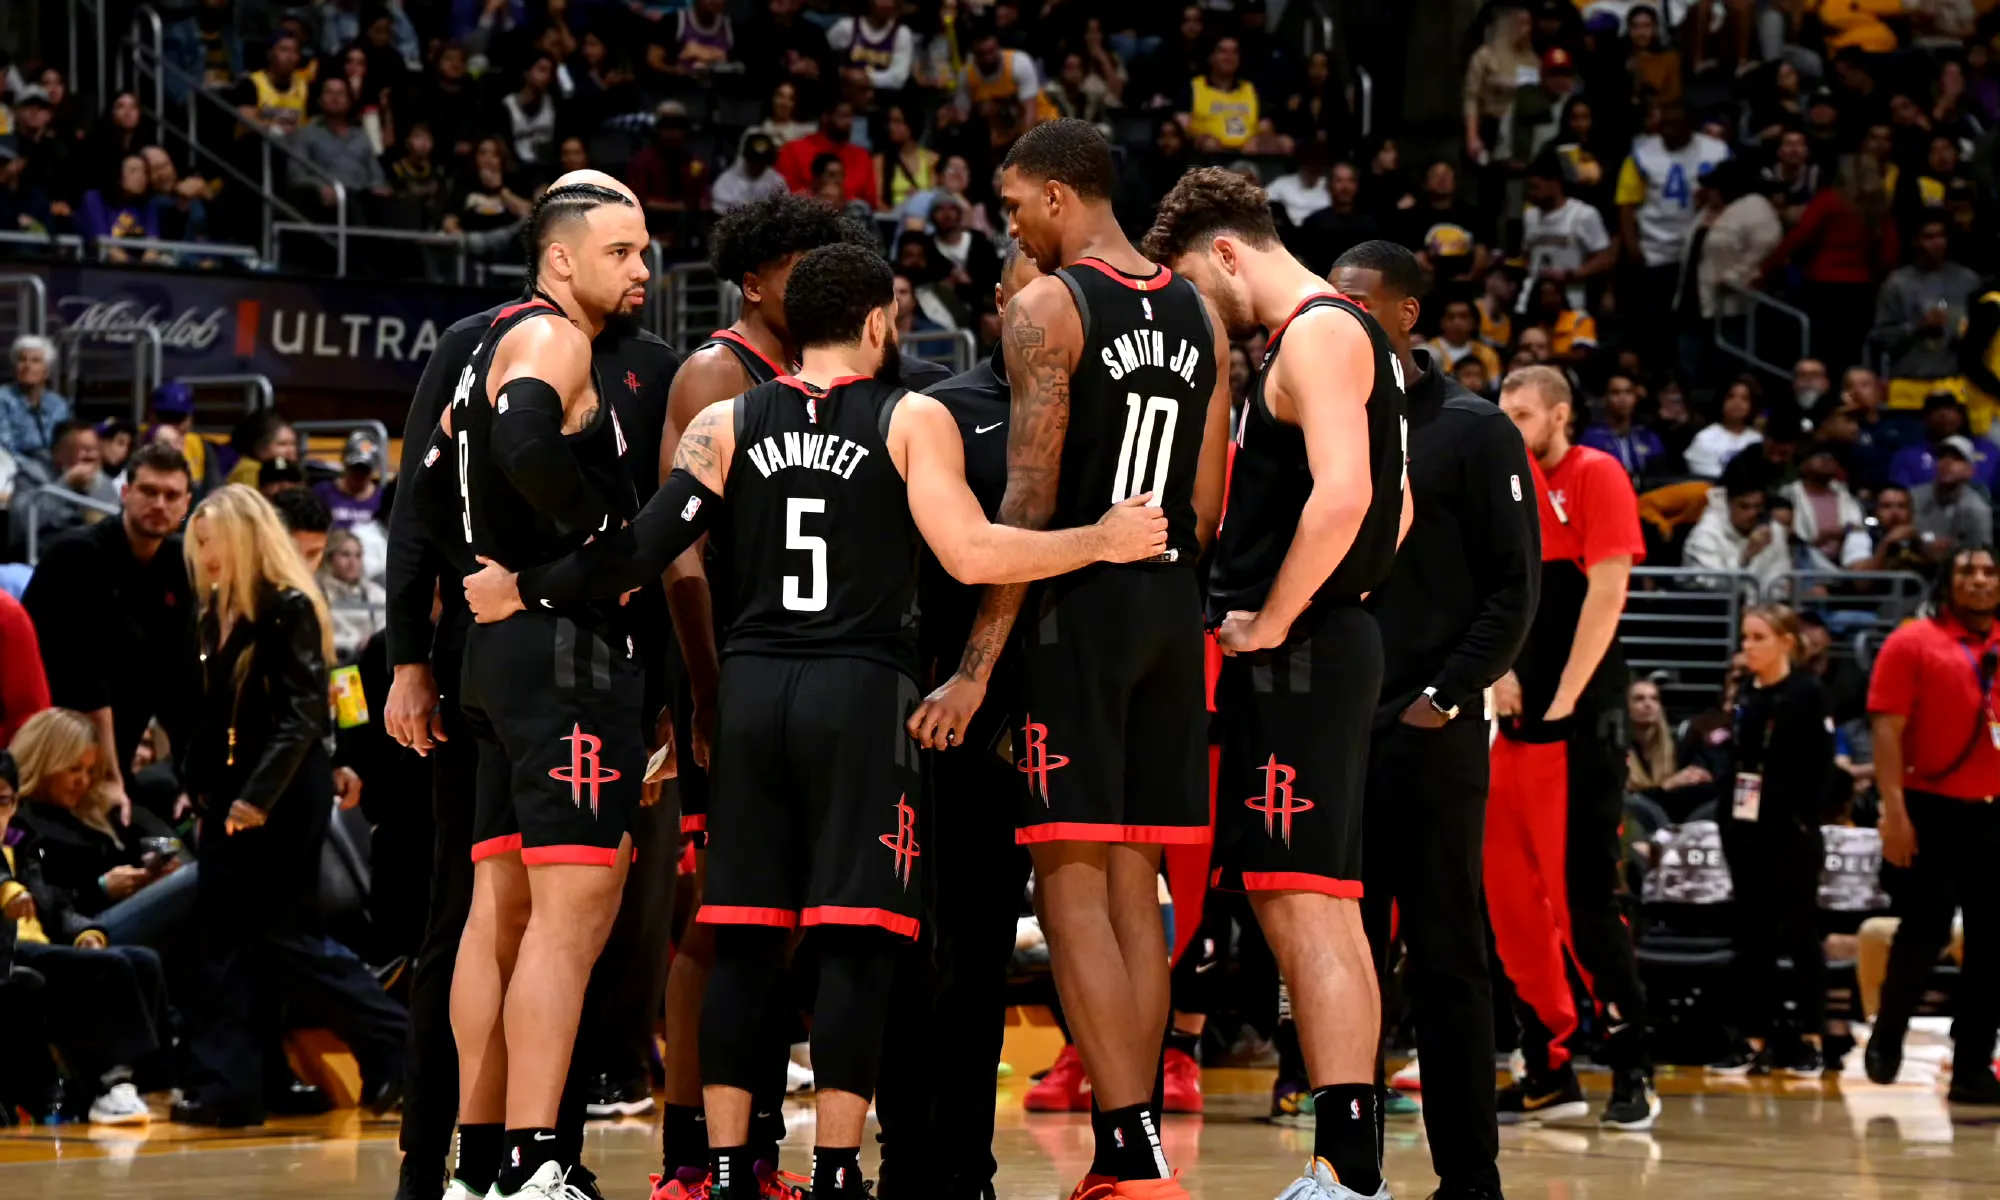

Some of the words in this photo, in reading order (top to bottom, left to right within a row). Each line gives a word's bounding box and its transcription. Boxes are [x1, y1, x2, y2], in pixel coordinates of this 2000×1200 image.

[271, 308, 438, 361] ULTRA
[1101, 329, 1164, 380] SMITH
[1169, 338, 1200, 389] JR.
[747, 431, 870, 480] VANVLEET
[1111, 392, 1179, 507] 10
[782, 497, 828, 612] 5
